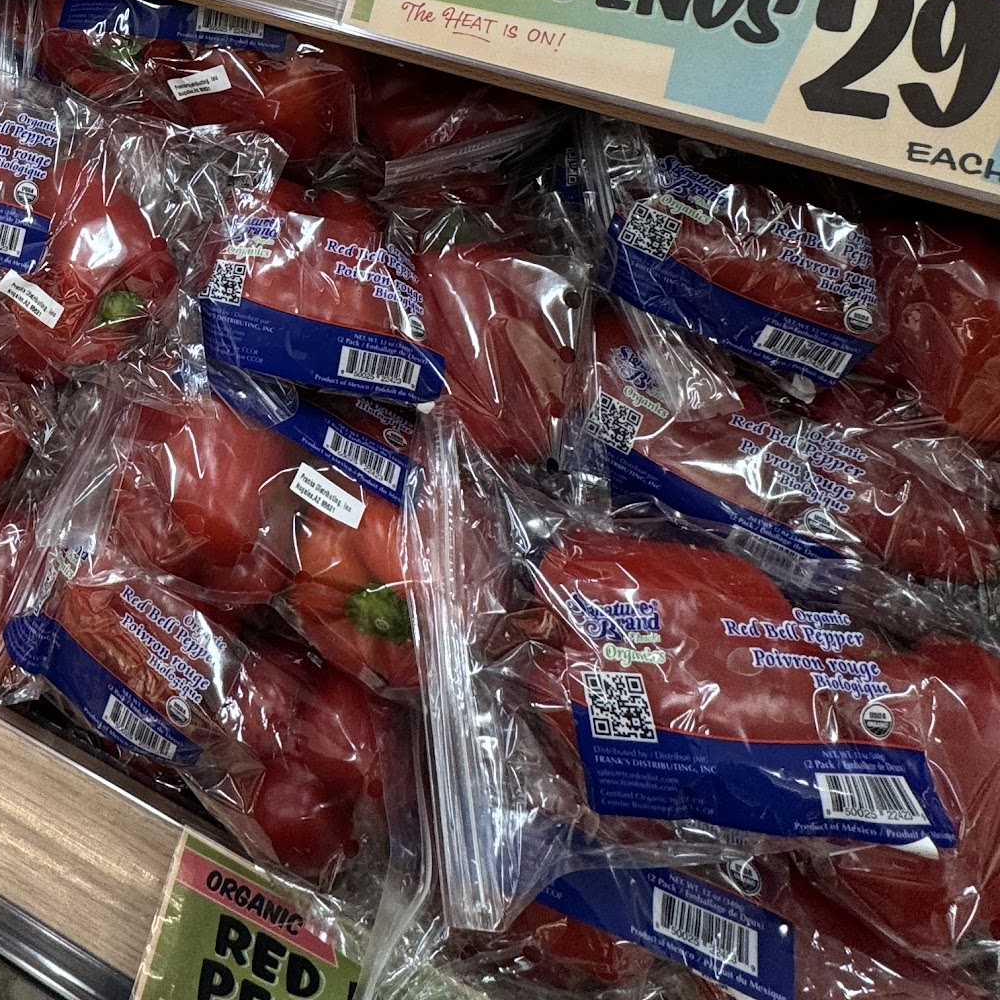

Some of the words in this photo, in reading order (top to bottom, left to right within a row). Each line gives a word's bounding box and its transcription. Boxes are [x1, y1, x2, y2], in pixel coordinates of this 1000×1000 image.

[401, 1, 437, 24] The
[442, 6, 498, 39] HEAT
[503, 23, 519, 40] IS
[526, 28, 567, 53] ON!
[14, 126, 58, 149] Pepper
[17, 113, 57, 132] Organic
[13, 149, 52, 168] rouge
[660, 195, 713, 226] Organics
[326, 238, 354, 259] Red
[779, 249, 840, 280] Poivron
[345, 338, 360, 348] Pack
[315, 374, 338, 385] Product
[623, 385, 670, 419] Organics
[730, 414, 766, 435] Red
[804, 442, 866, 479] Pepper
[808, 430, 869, 463] Organic
[778, 472, 850, 516] Biologique
[803, 468, 855, 500] rouge
[121, 584, 148, 613] Red
[147, 605, 176, 634] Bell
[793, 606, 851, 628] Organic
[597, 612, 662, 639] Brand
[722, 618, 760, 638] Red
[764, 620, 800, 642] Bell
[803, 624, 865, 651] Pepper
[120, 612, 171, 661] Poivron
[170, 653, 210, 690] rouge
[603, 644, 667, 665] Organics
[751, 647, 825, 672] Poivron
[827, 658, 881, 682] rouge
[147, 654, 204, 704] Biologique
[813, 672, 891, 699] Biologique
[173, 702, 187, 715] USDA
[868, 710, 887, 720] USDA
[594, 754, 631, 766] FRANK'S
[632, 759, 699, 774] DISTRIBUTING,
[700, 765, 718, 775] INC
[815, 760, 834, 769] Pack
[794, 821, 828, 831] Product
[206, 869, 304, 936] ORGANIC
[658, 876, 678, 894] Pack
[685, 887, 727, 914] Emballage
[215, 913, 321, 998] RED
[735, 971, 748, 986] du
[749, 978, 787, 1000] Mexique
